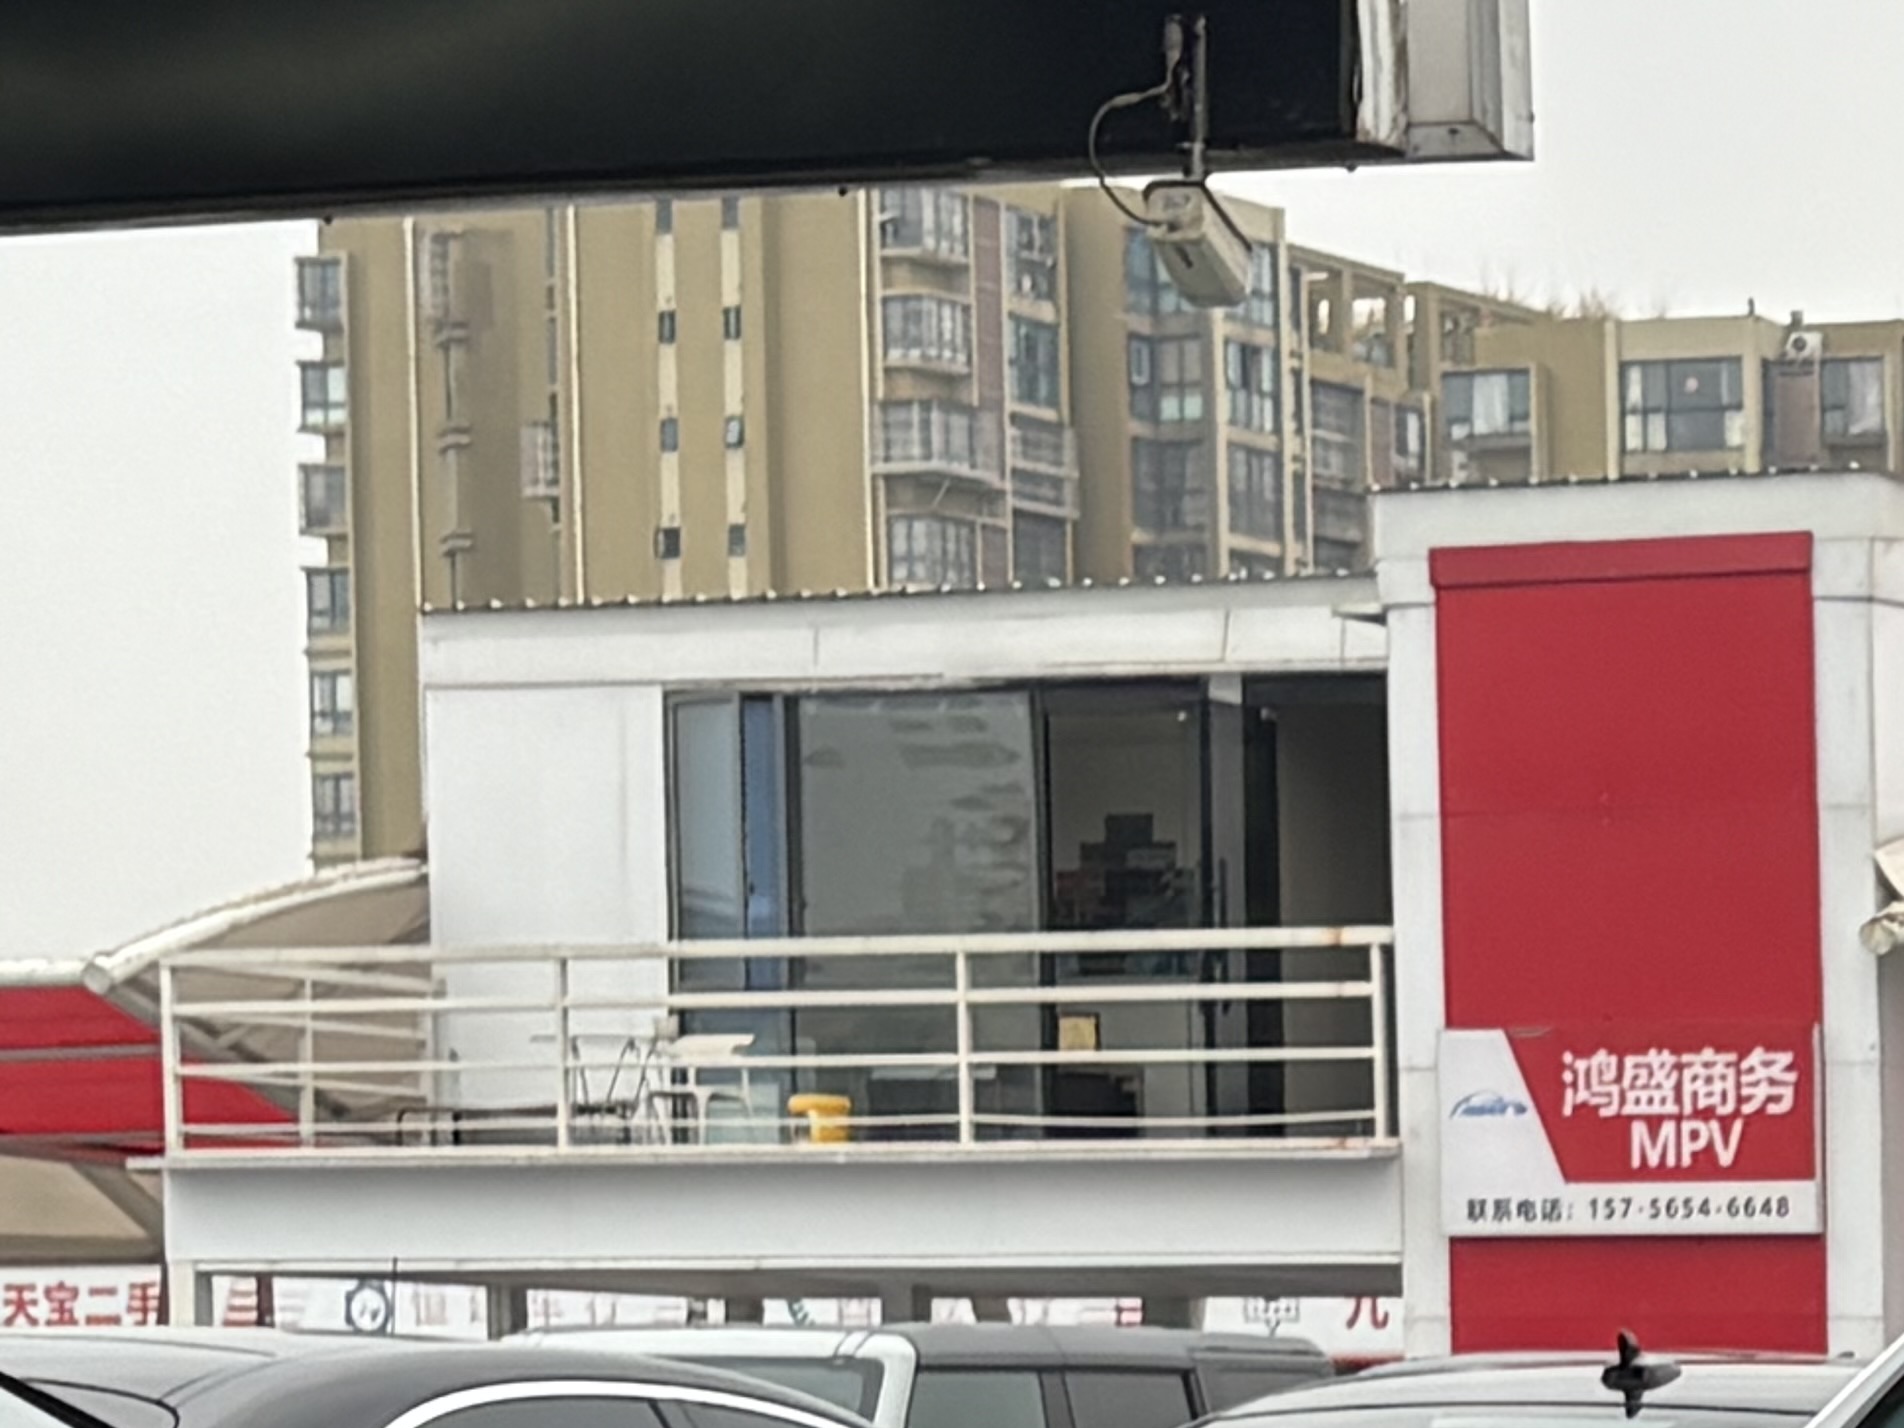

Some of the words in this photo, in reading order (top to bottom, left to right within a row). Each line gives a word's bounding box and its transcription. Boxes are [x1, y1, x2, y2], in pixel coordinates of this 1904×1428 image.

[1562, 1046, 1798, 1117] 鸿盛商务
[1631, 1117, 1744, 1169] MPV
[3, 1281, 158, 1326] 天宝二手
